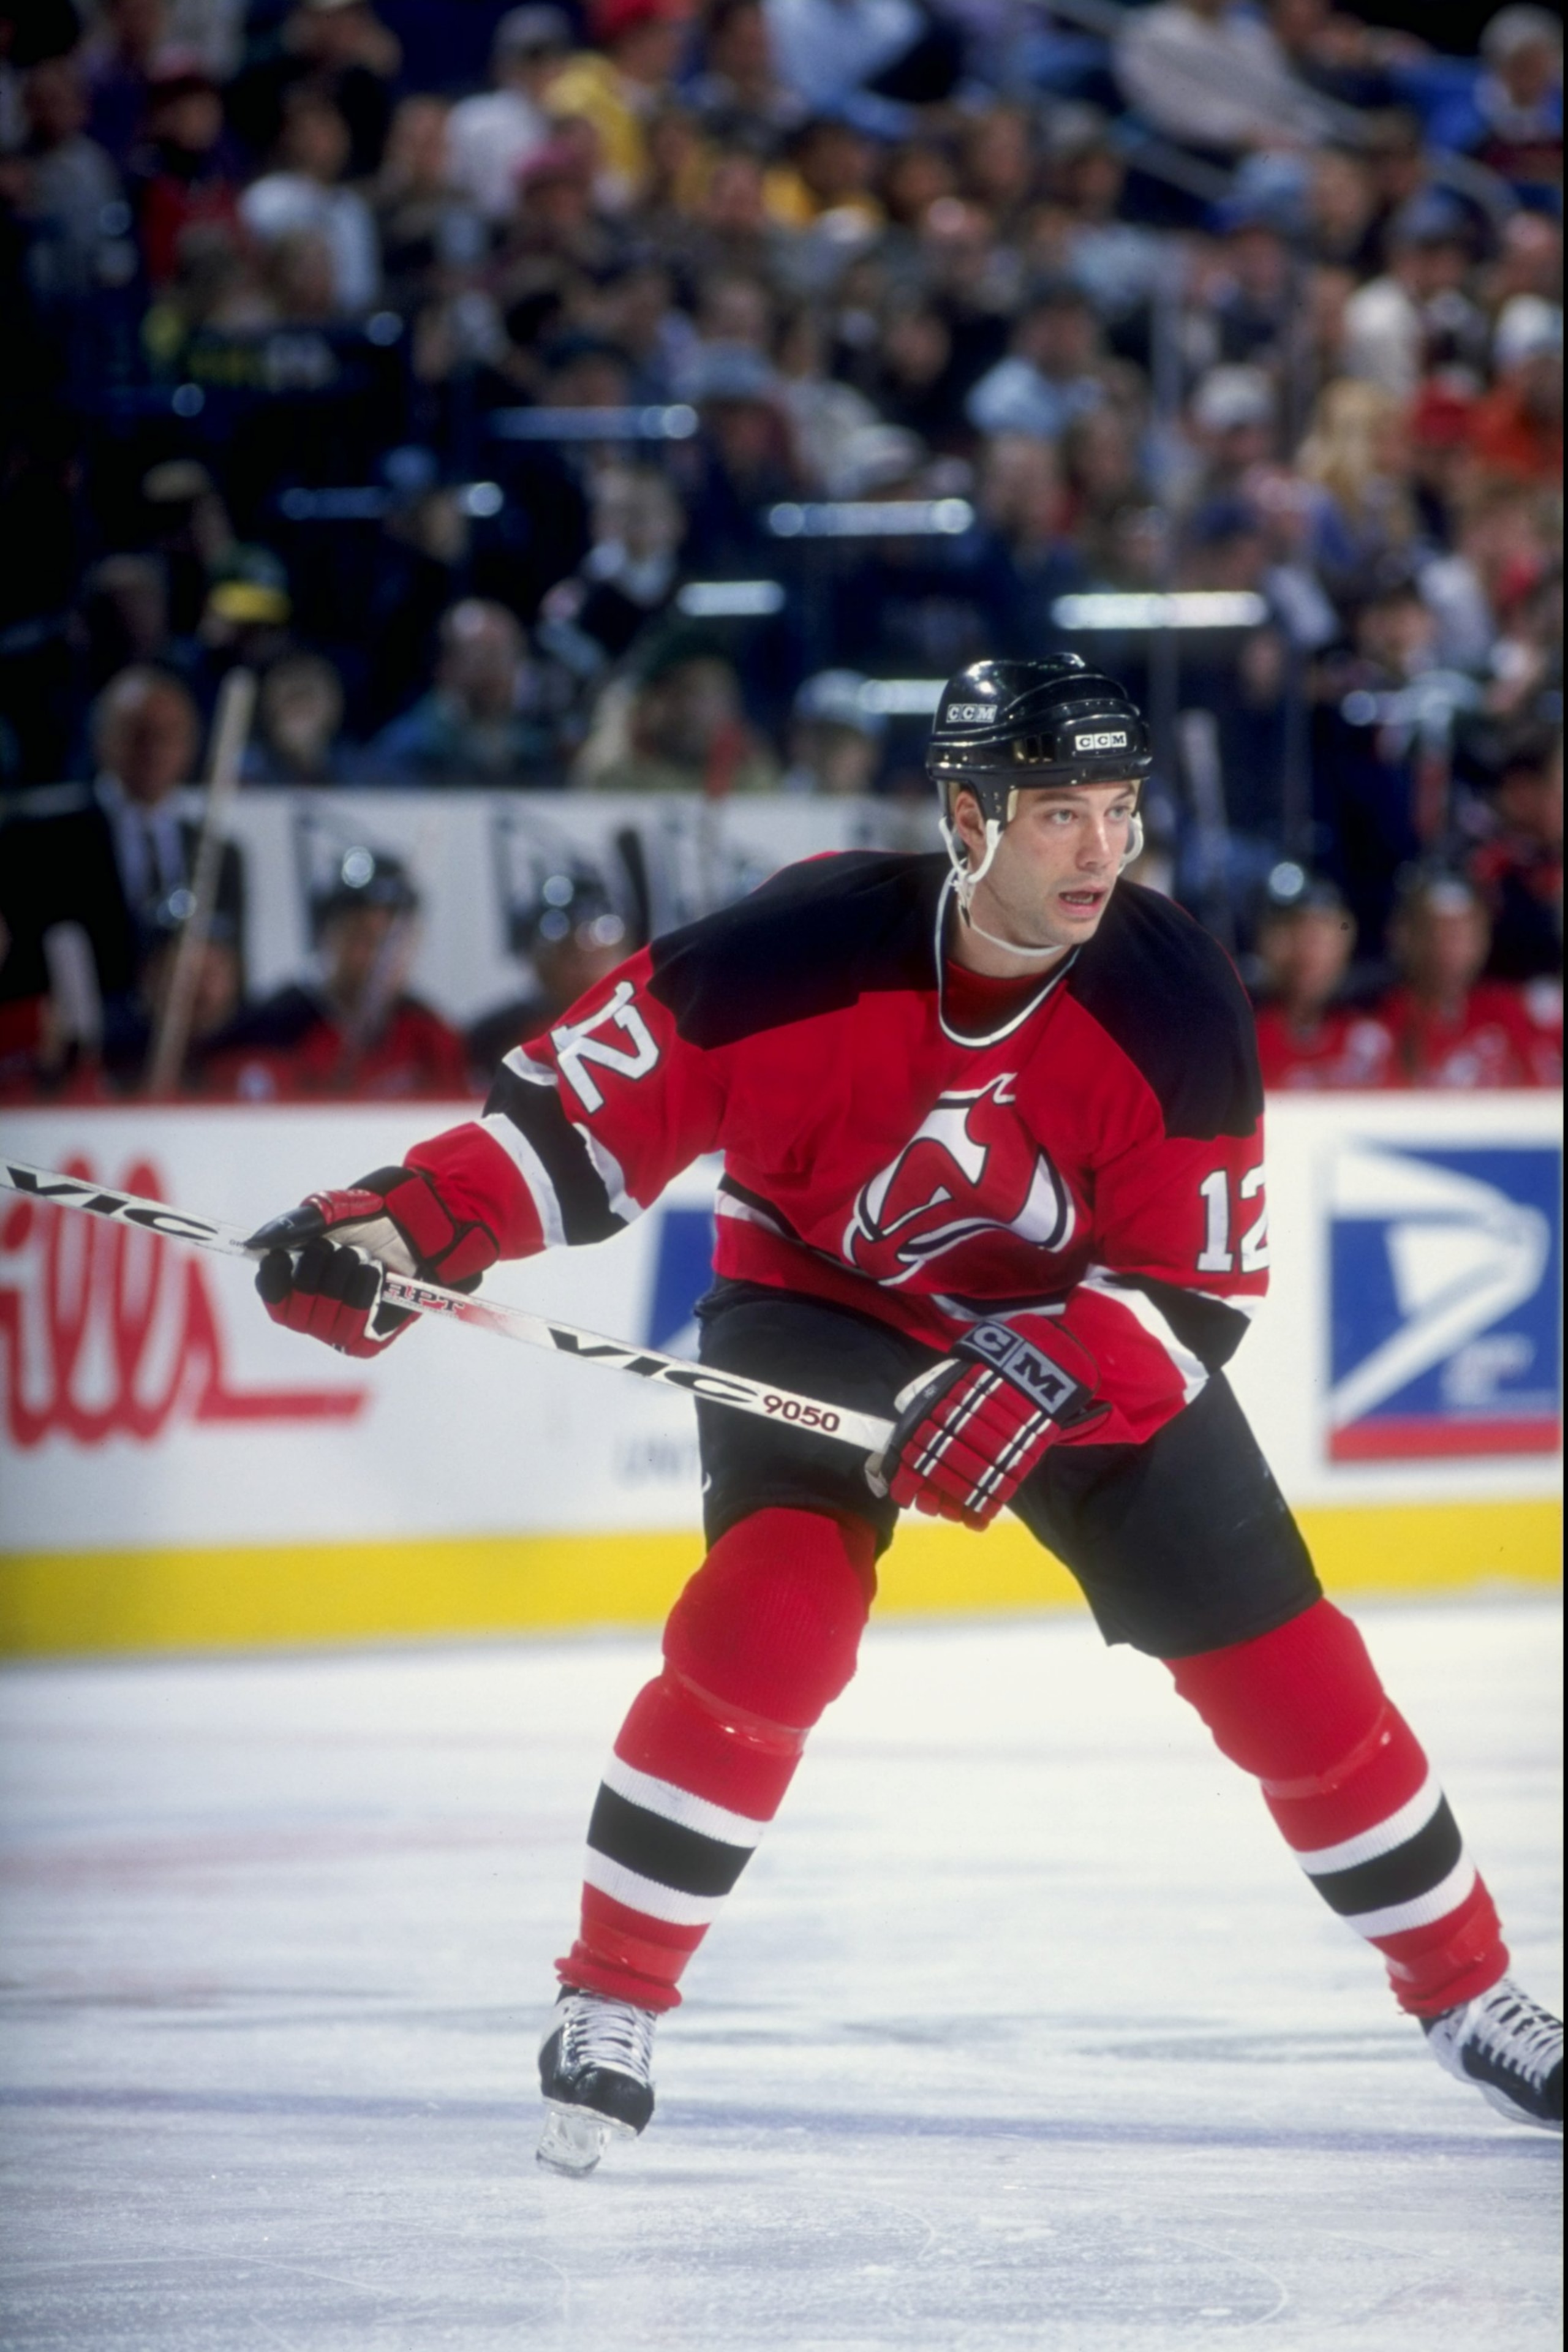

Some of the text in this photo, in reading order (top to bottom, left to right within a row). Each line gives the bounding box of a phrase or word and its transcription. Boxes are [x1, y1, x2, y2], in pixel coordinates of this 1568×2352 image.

[948, 705, 995, 721] CCM
[1079, 735, 1125, 748] CCM
[551, 980, 660, 1114] 12
[6, 1166, 218, 1241] VIC
[1197, 1168, 1270, 1273] 12
[548, 1327, 840, 1432] VIC 9050
